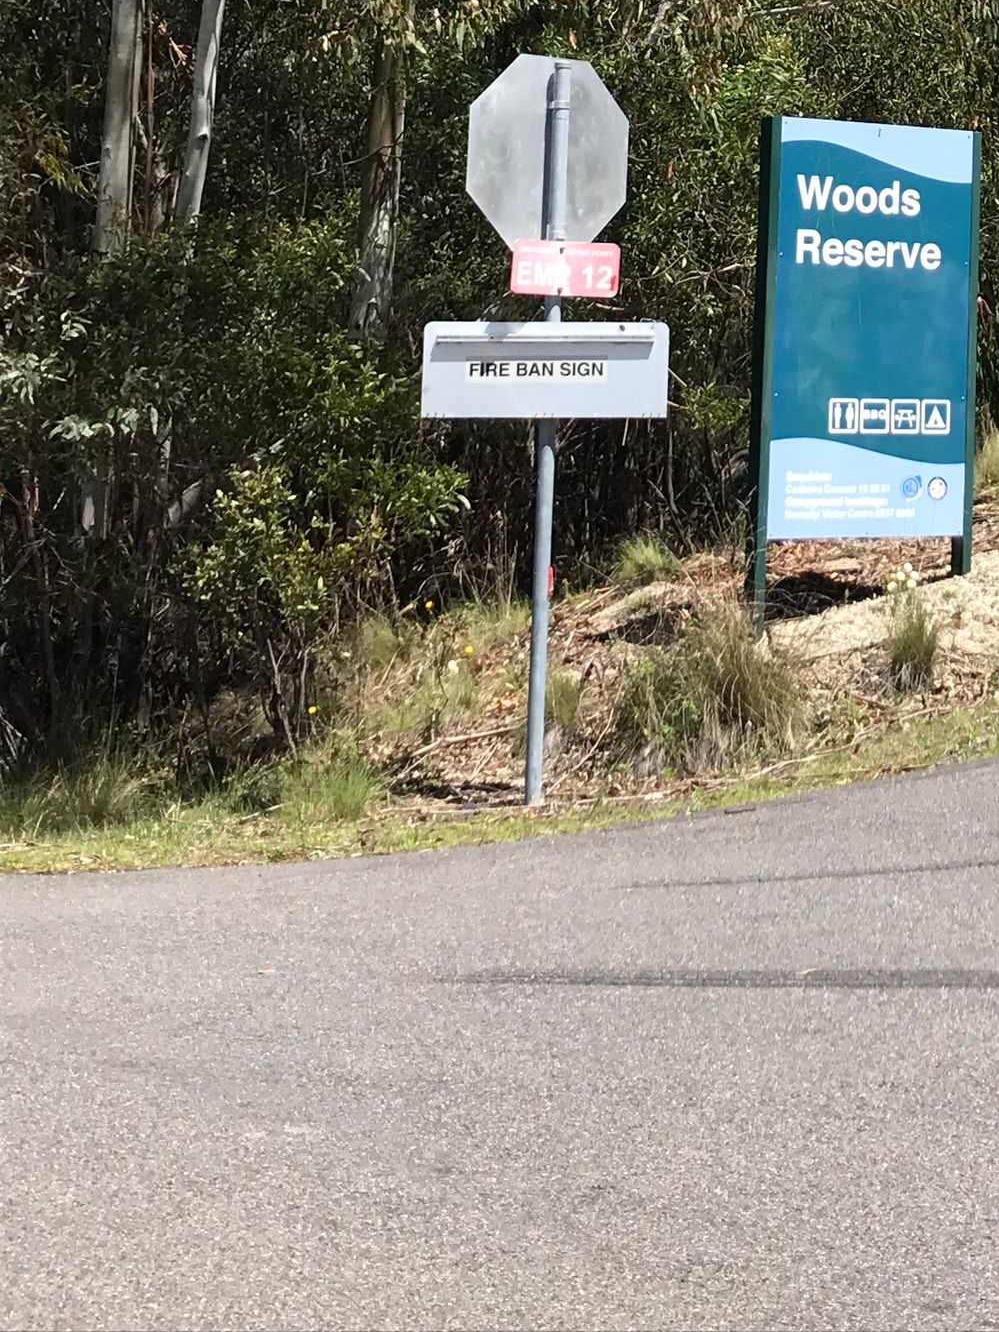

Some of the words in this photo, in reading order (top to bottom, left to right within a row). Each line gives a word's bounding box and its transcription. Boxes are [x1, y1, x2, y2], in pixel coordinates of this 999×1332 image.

[797, 174, 921, 217] Woods
[795, 228, 942, 271] Reserve
[582, 264, 613, 289] 12
[469, 362, 510, 377] FIRE
[516, 362, 554, 376] BAN
[560, 361, 604, 376] SIGN
